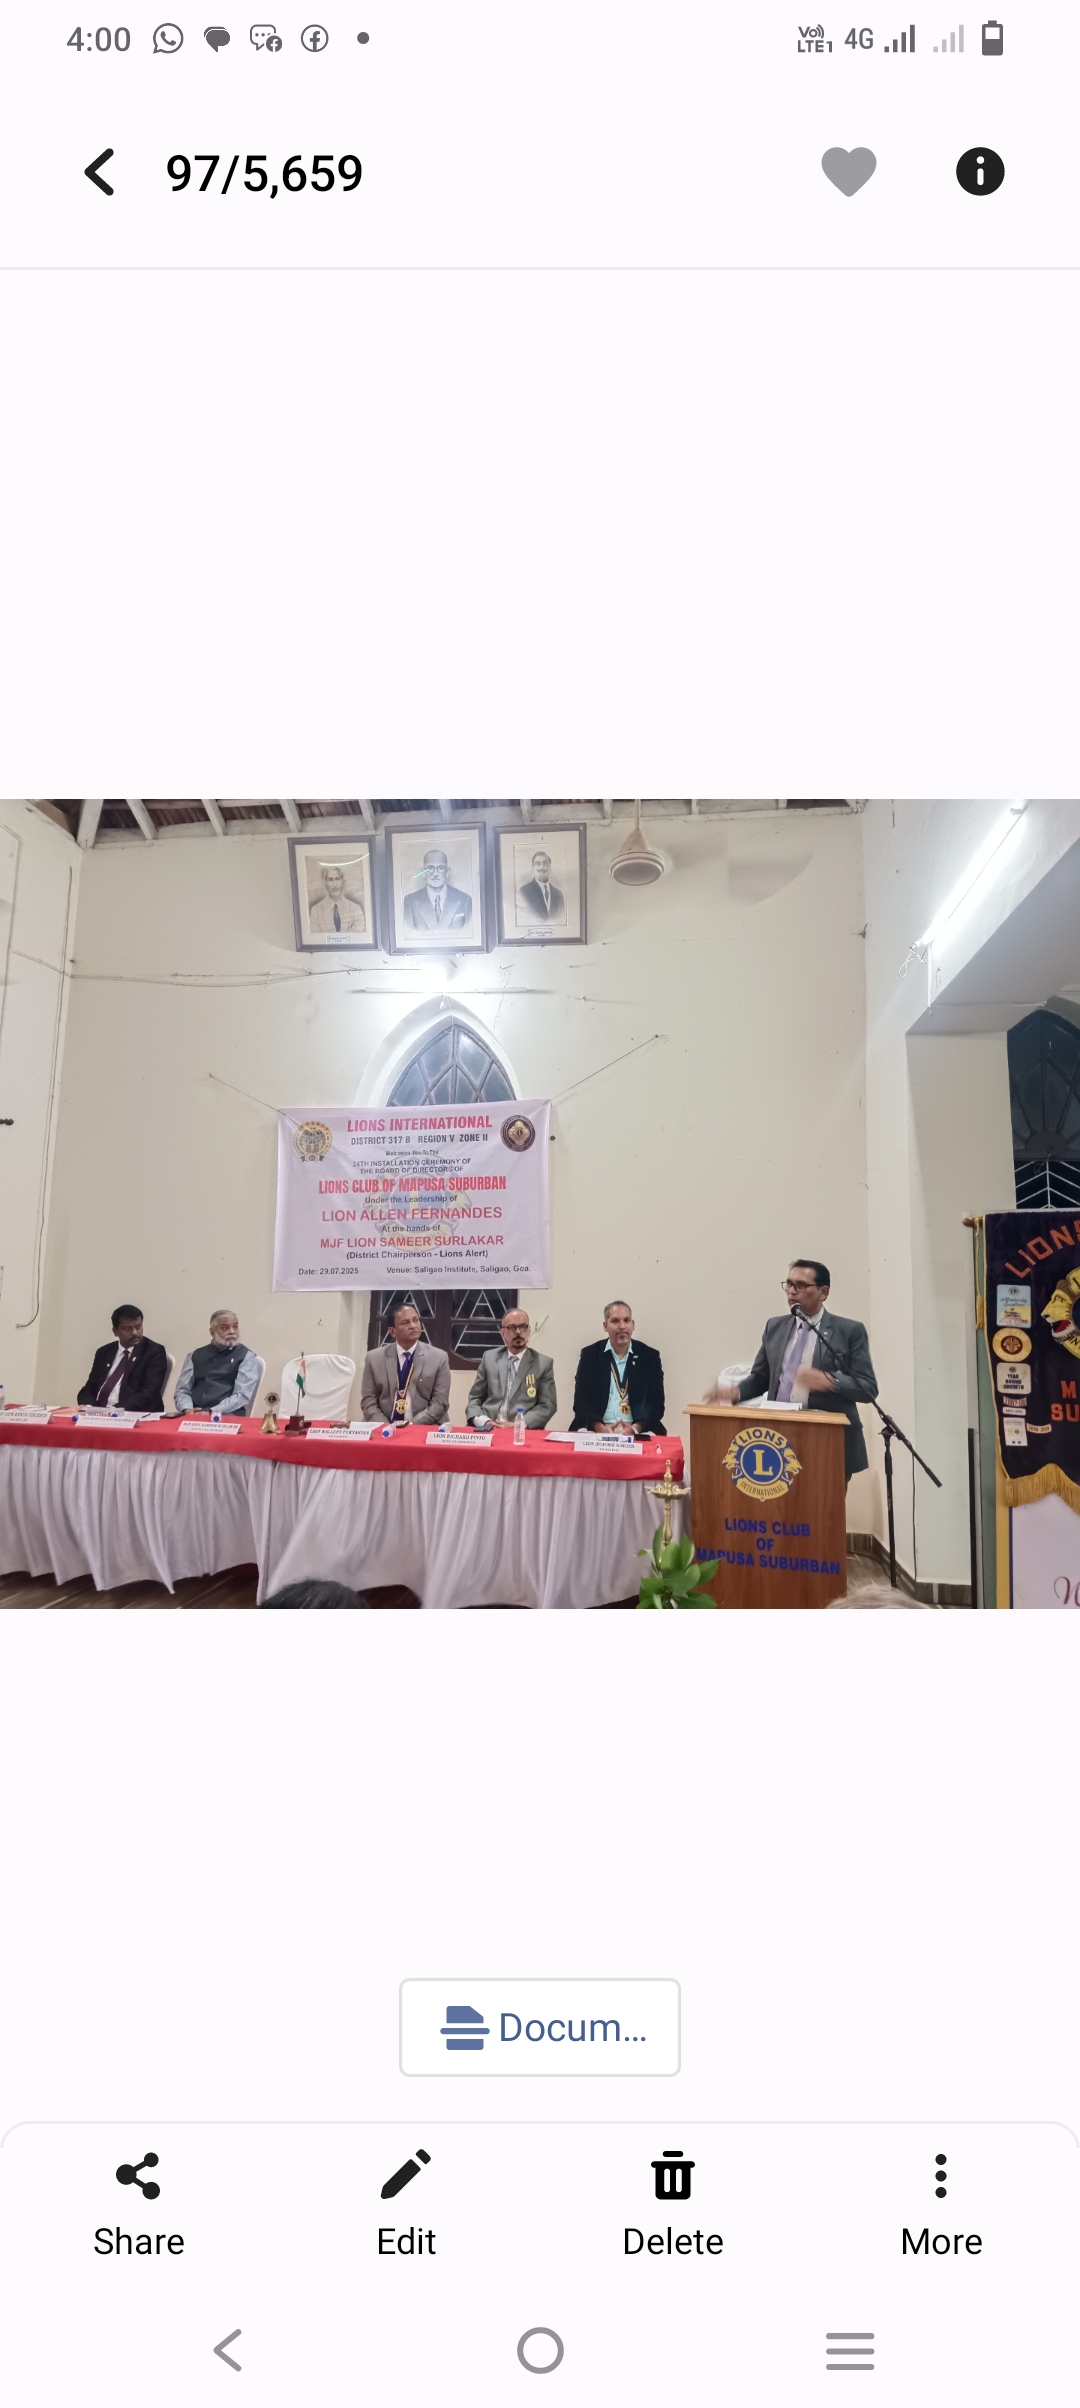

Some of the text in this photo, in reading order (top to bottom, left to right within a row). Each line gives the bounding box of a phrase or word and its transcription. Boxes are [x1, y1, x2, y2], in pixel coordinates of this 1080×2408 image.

[67, 27, 130, 51] 4:00
[844, 28, 873, 49] 4G
[167, 155, 362, 199] 97/5,659
[347, 1115, 492, 1132] LIONS INTERNATIONAL
[351, 1136, 386, 1145] DISTRICT
[388, 1135, 402, 1144] 317
[418, 1134, 447, 1143] REGION
[449, 1134, 454, 1142] V
[459, 1133, 480, 1142] ZONE
[482, 1133, 488, 1141] II
[371, 1159, 420, 1167] INSTALLATION
[319, 1176, 506, 1194] LIONS CLUB OF MAPUSA SUBURBAN
[365, 1196, 388, 1204] Under
[404, 1195, 447, 1203] Leadership
[449, 1194, 457, 1202] of
[322, 1207, 503, 1222] LION ALLEN FERNANDES
[406, 1224, 430, 1232] hands
[320, 1235, 504, 1248] MJF LION SAMEER SURLAKAR
[346, 1251, 379, 1260] (District
[381, 1250, 431, 1259] Chairperson
[439, 1250, 463, 1258] Lions
[465, 1249, 488, 1258] Alert)
[319, 1267, 359, 1275] 29.07.2025
[386, 1266, 412, 1274] Venue:
[414, 1266, 443, 1274] Saligao
[444, 1265, 478, 1274] Institute,
[480, 1265, 511, 1273] Saligao,
[513, 1264, 531, 1272] Goa.
[738, 1428, 784, 1447] LIONS
[753, 1449, 773, 1476] L
[739, 1481, 786, 1497] INTERNATIONAL
[724, 1517, 811, 1537] LIONS CLUB
[756, 1537, 775, 1551] OF
[759, 1554, 841, 1575] SUBURBAN
[94, 2227, 184, 2255] Share
[379, 2227, 436, 2255] Edit
[625, 2227, 723, 2255] Delete
[903, 2228, 982, 2255] More
